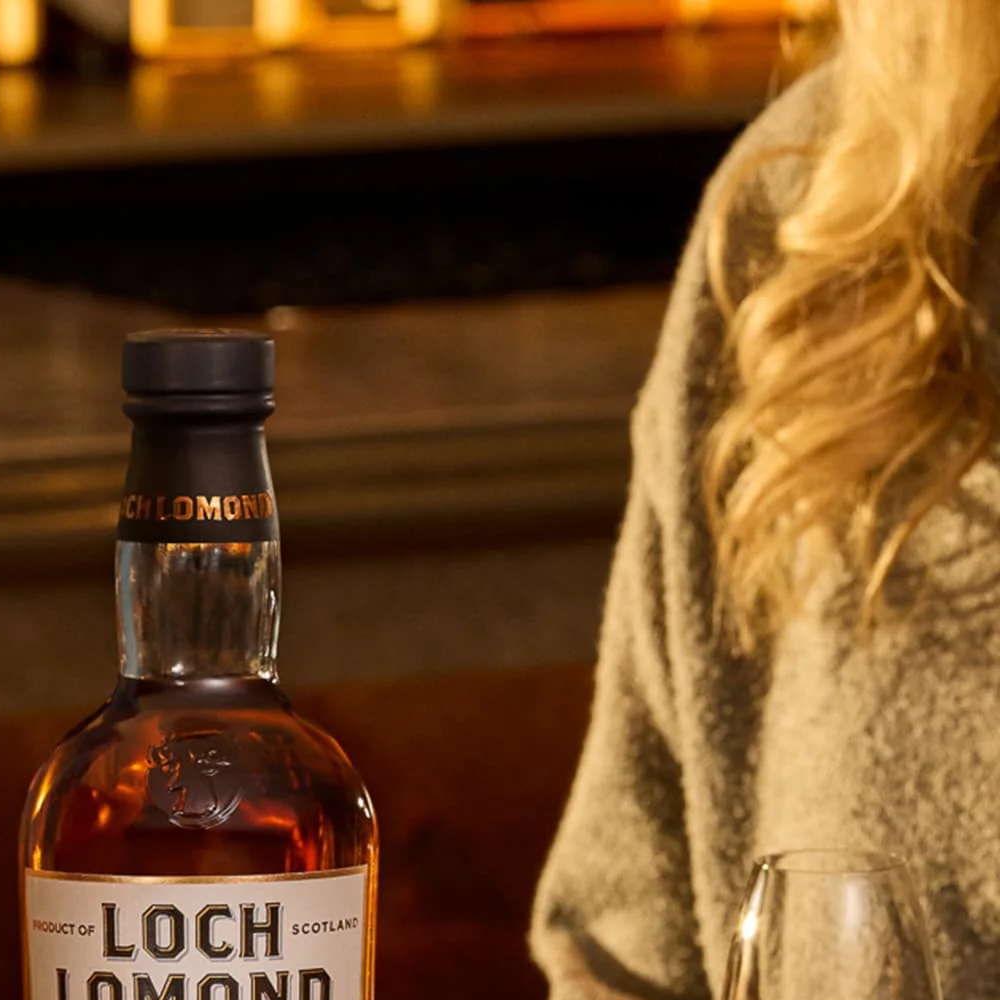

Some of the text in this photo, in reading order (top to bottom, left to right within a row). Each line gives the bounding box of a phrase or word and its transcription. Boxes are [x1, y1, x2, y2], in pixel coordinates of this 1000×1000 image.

[156, 492, 273, 521] LOMOND
[33, 919, 95, 936] PRODUCT OF
[102, 902, 282, 960] LOCH
[292, 917, 358, 935] SCOTLAND
